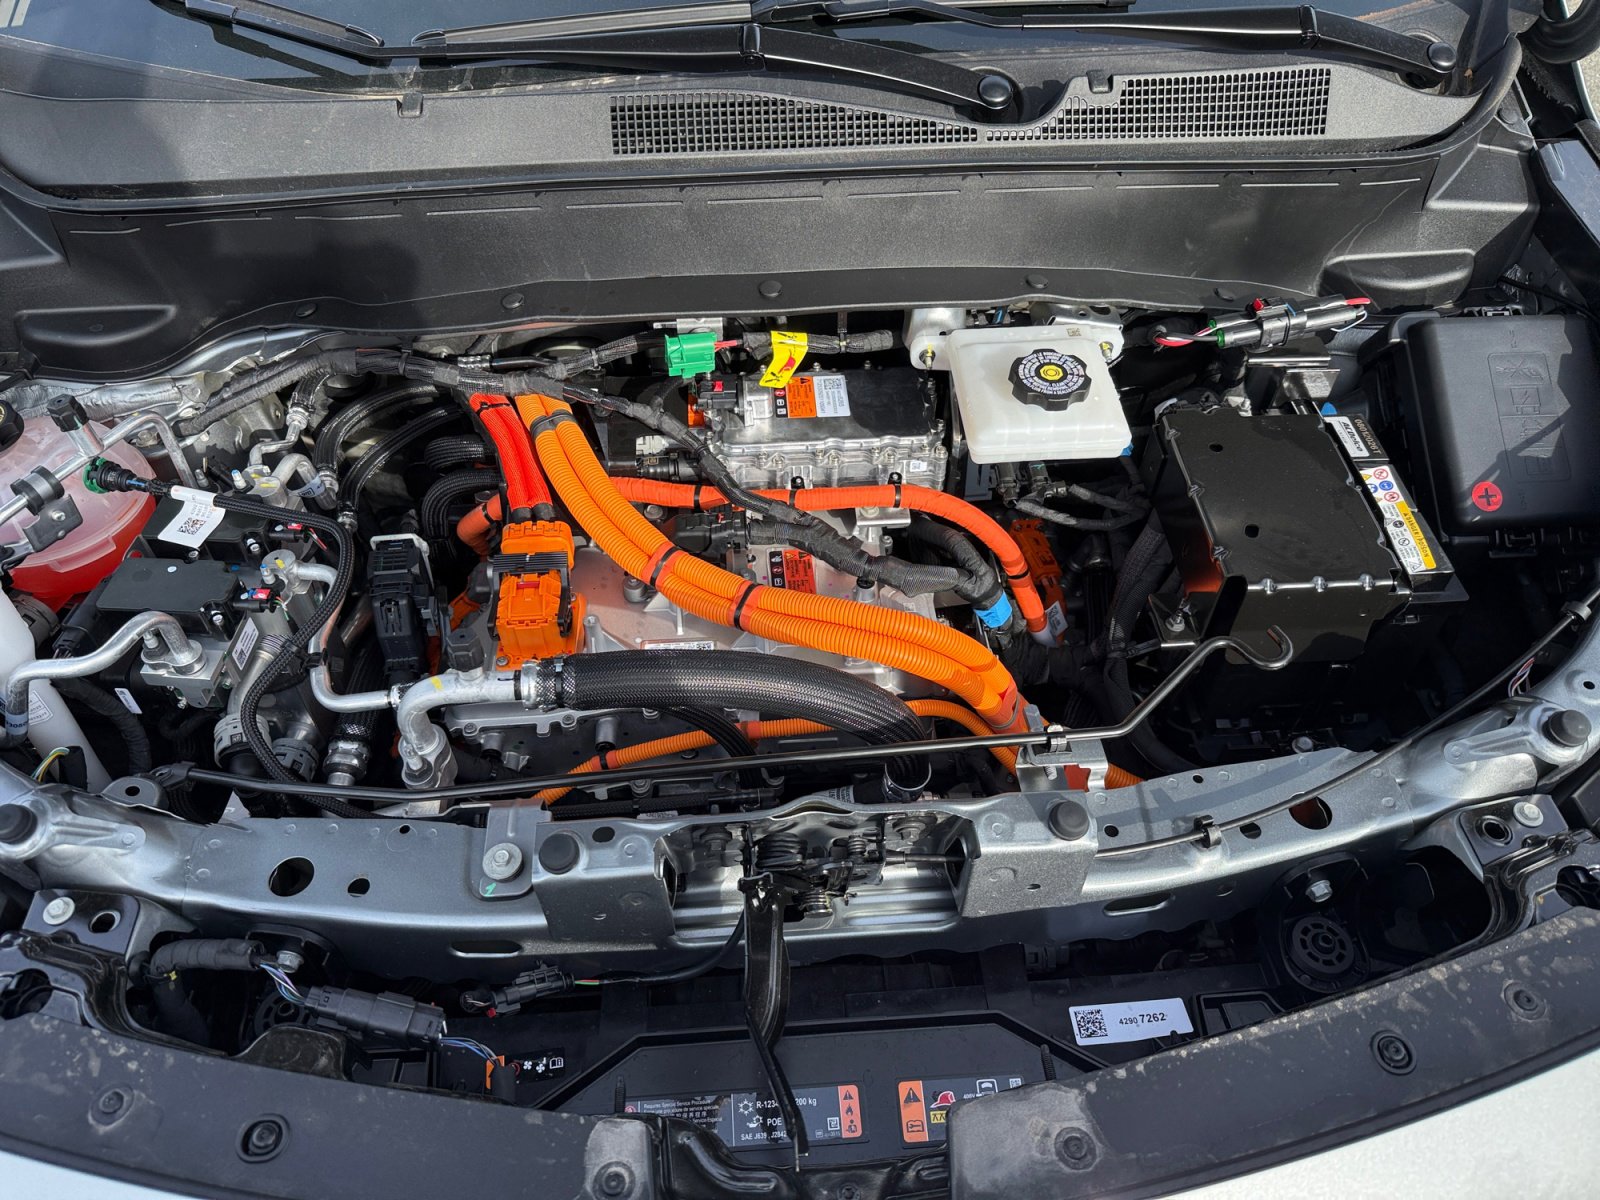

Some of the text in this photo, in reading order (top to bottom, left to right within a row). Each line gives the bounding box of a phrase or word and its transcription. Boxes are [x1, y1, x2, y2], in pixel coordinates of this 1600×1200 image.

[1119, 1012, 1167, 1025] 4290 7262
[808, 1097, 817, 1107] kg
[766, 1117, 783, 1126] POE
[741, 1132, 753, 1141] SAE
